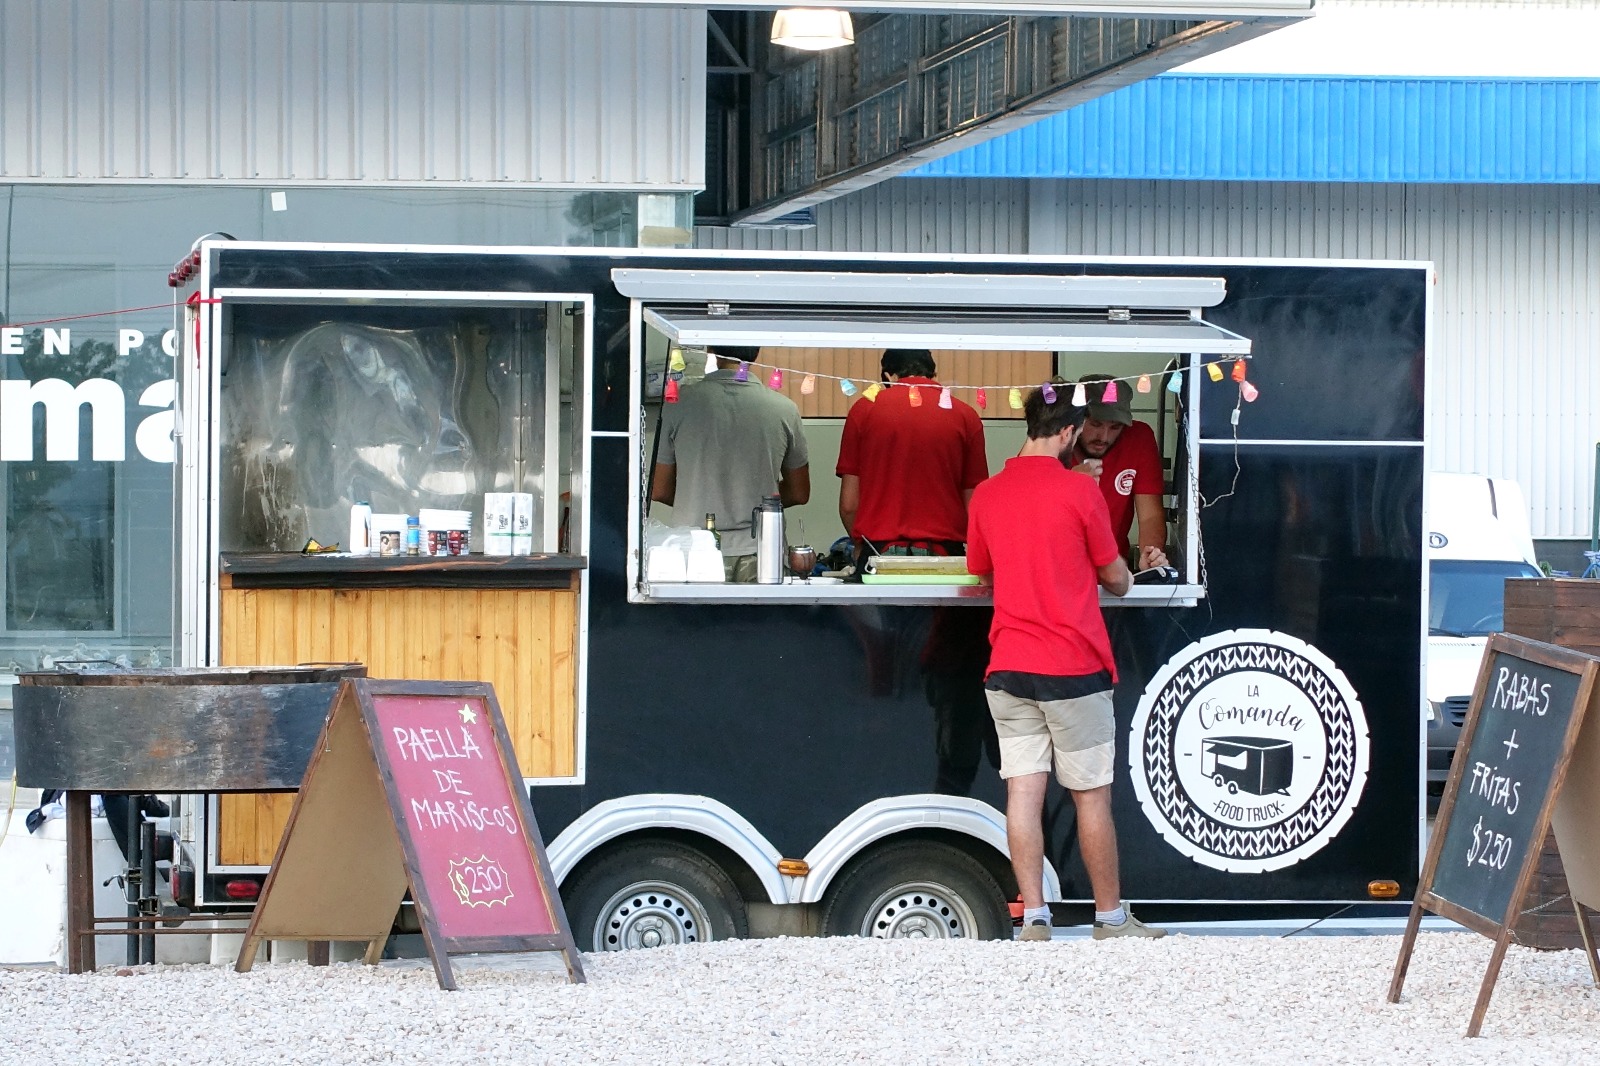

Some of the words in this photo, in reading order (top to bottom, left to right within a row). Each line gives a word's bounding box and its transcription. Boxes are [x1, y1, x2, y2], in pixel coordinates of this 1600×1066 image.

[2, 328, 71, 355] EN
[1247, 685, 1260, 698] LA
[1492, 666, 1552, 717] RABAS
[1199, 698, 1306, 732] Comanda
[393, 726, 484, 762] PAELLA
[432, 769, 473, 796] DE
[1467, 816, 1513, 870] $250
[455, 865, 502, 901] $250
